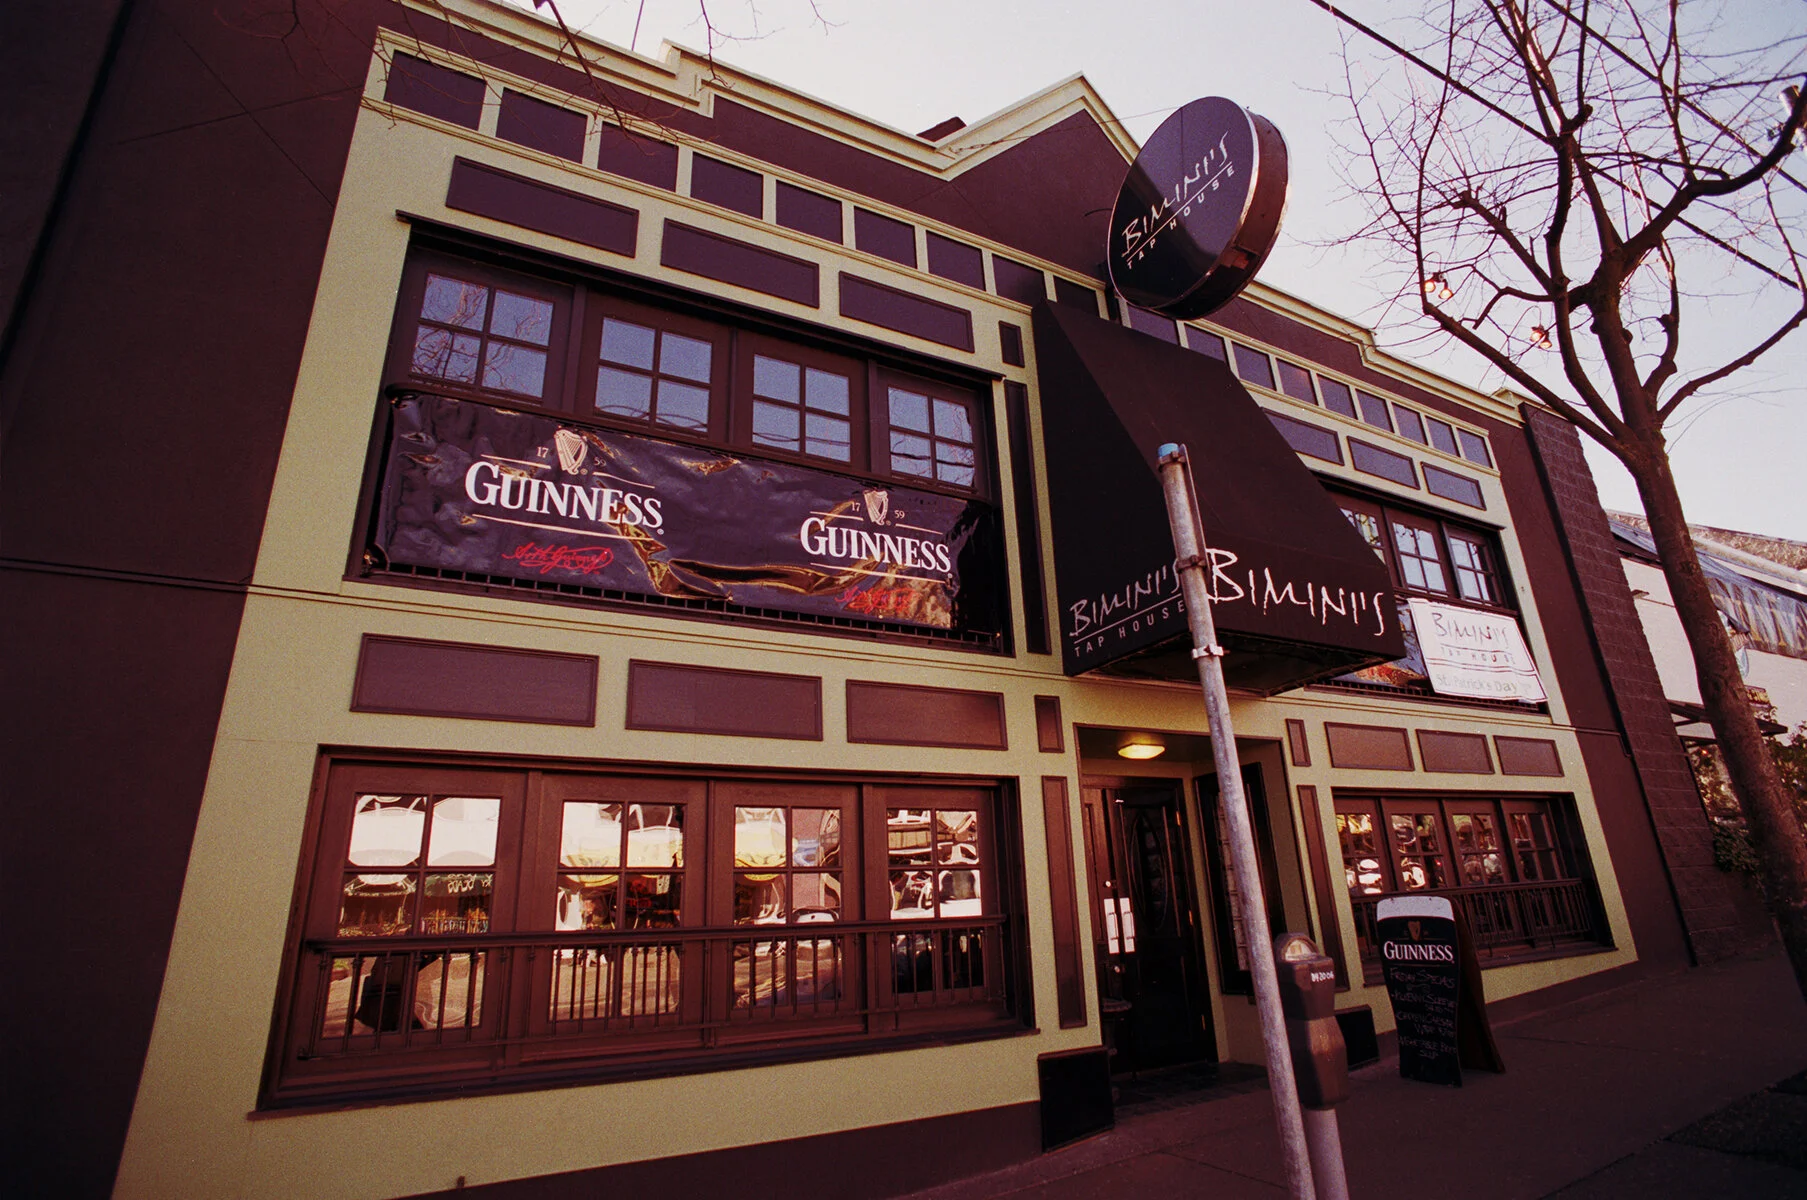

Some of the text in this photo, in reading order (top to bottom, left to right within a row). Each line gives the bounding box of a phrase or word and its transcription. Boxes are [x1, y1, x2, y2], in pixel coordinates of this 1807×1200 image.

[1121, 130, 1229, 258] BIMINI'S
[1127, 165, 1235, 270] TAP HOUSE
[536, 446, 606, 468] 17 59
[465, 461, 663, 528] GUINNESS
[851, 502, 906, 519] 17 59
[800, 517, 952, 573] GUINNESS
[1074, 601, 1186, 658] TAP HOUSE
[1383, 940, 1454, 961] GUINNESS
